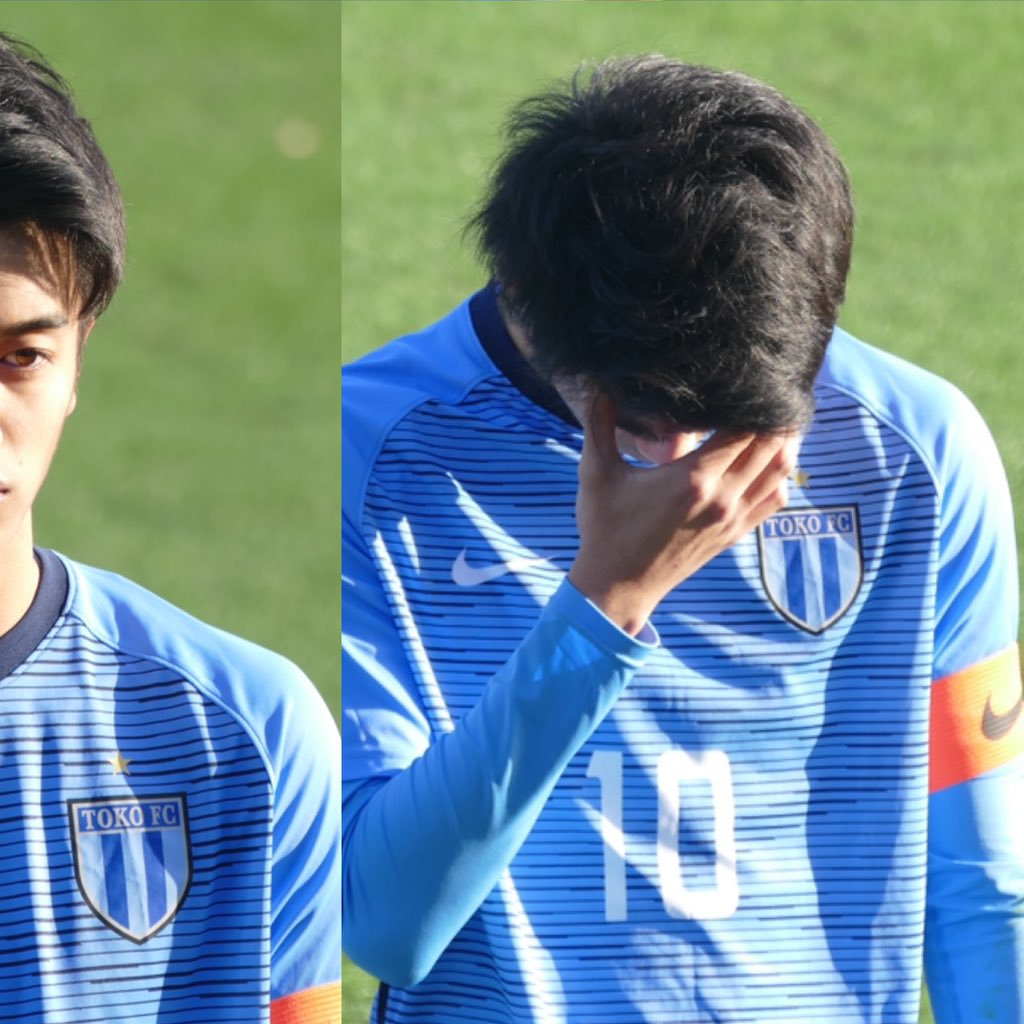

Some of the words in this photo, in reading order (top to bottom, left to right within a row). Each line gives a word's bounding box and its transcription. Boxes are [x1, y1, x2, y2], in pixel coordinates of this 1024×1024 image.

[766, 515, 821, 536] TOKO
[827, 514, 849, 533] FC
[81, 806, 145, 830] TOKO
[150, 804, 176, 825] FC
[586, 749, 740, 922] 10
